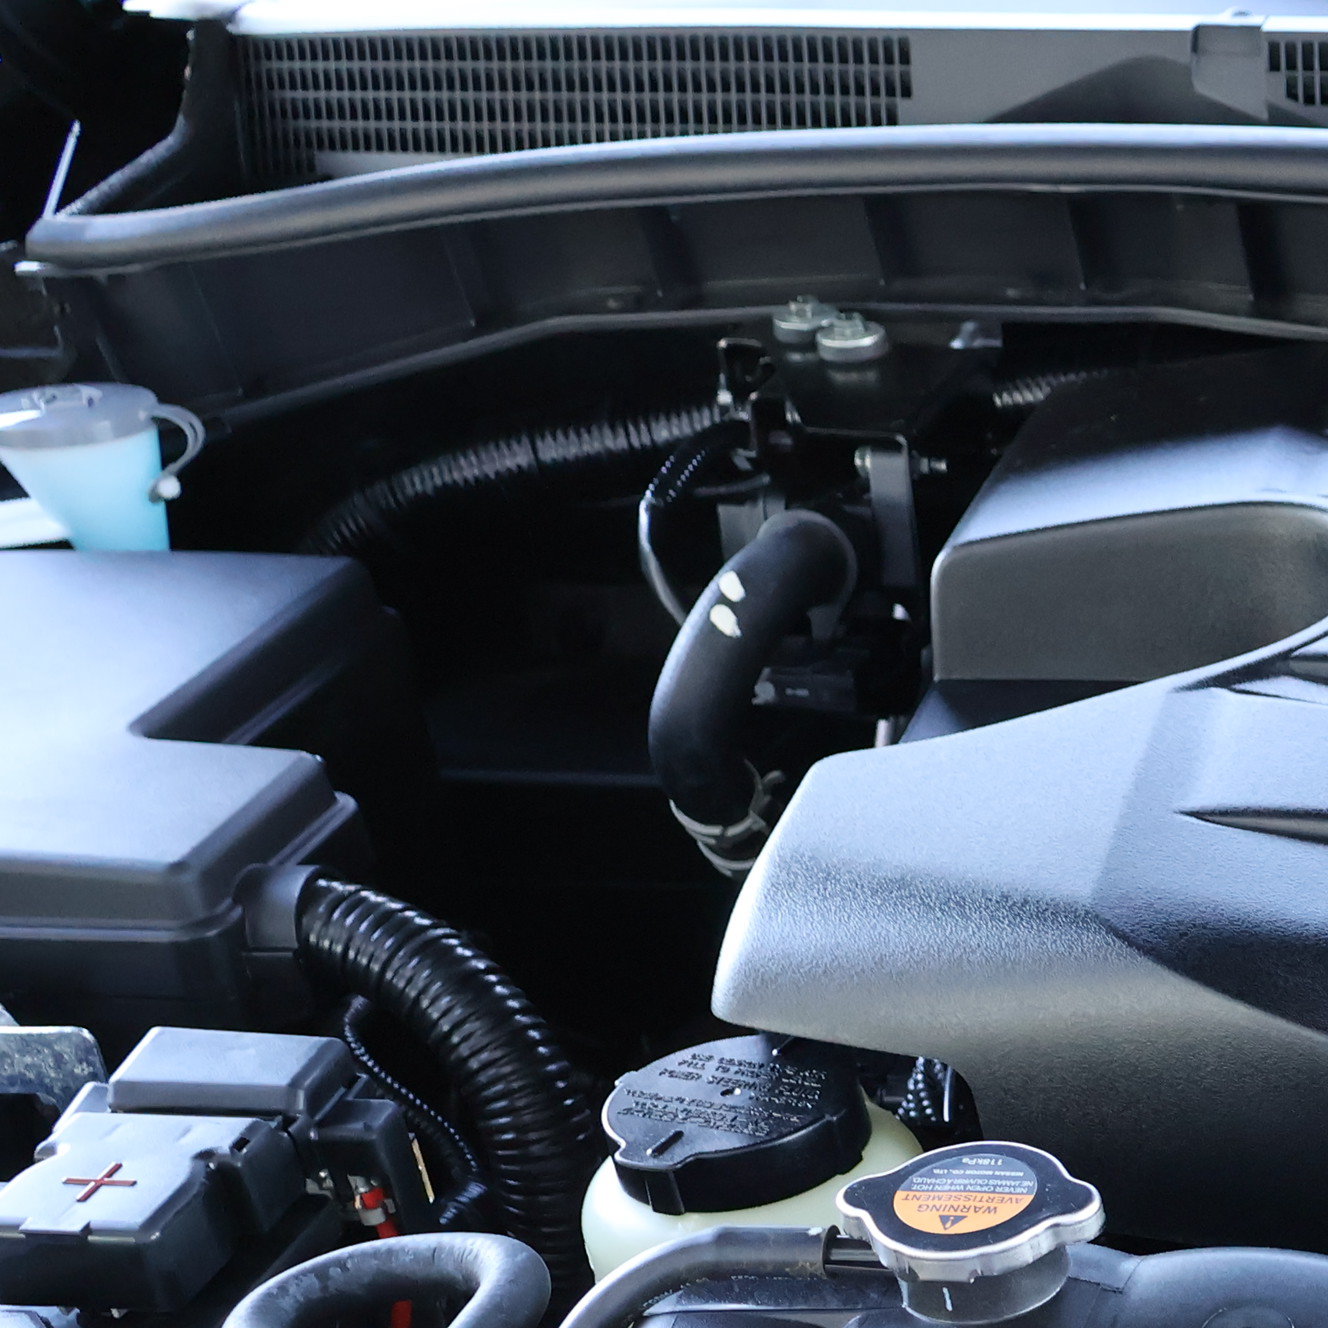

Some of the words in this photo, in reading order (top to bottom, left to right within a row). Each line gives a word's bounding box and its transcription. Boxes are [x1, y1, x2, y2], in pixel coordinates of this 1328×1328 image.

[962, 1157, 1003, 1166] 118kPa
[988, 1178, 1022, 1186] JAMAIS
[932, 1183, 965, 1191] WHEN
[968, 1184, 994, 1192] OPEN
[995, 1185, 1028, 1193] NEVER
[901, 1193, 1024, 1204] AVERTISSEMENT
[917, 1204, 998, 1215] WARNING
